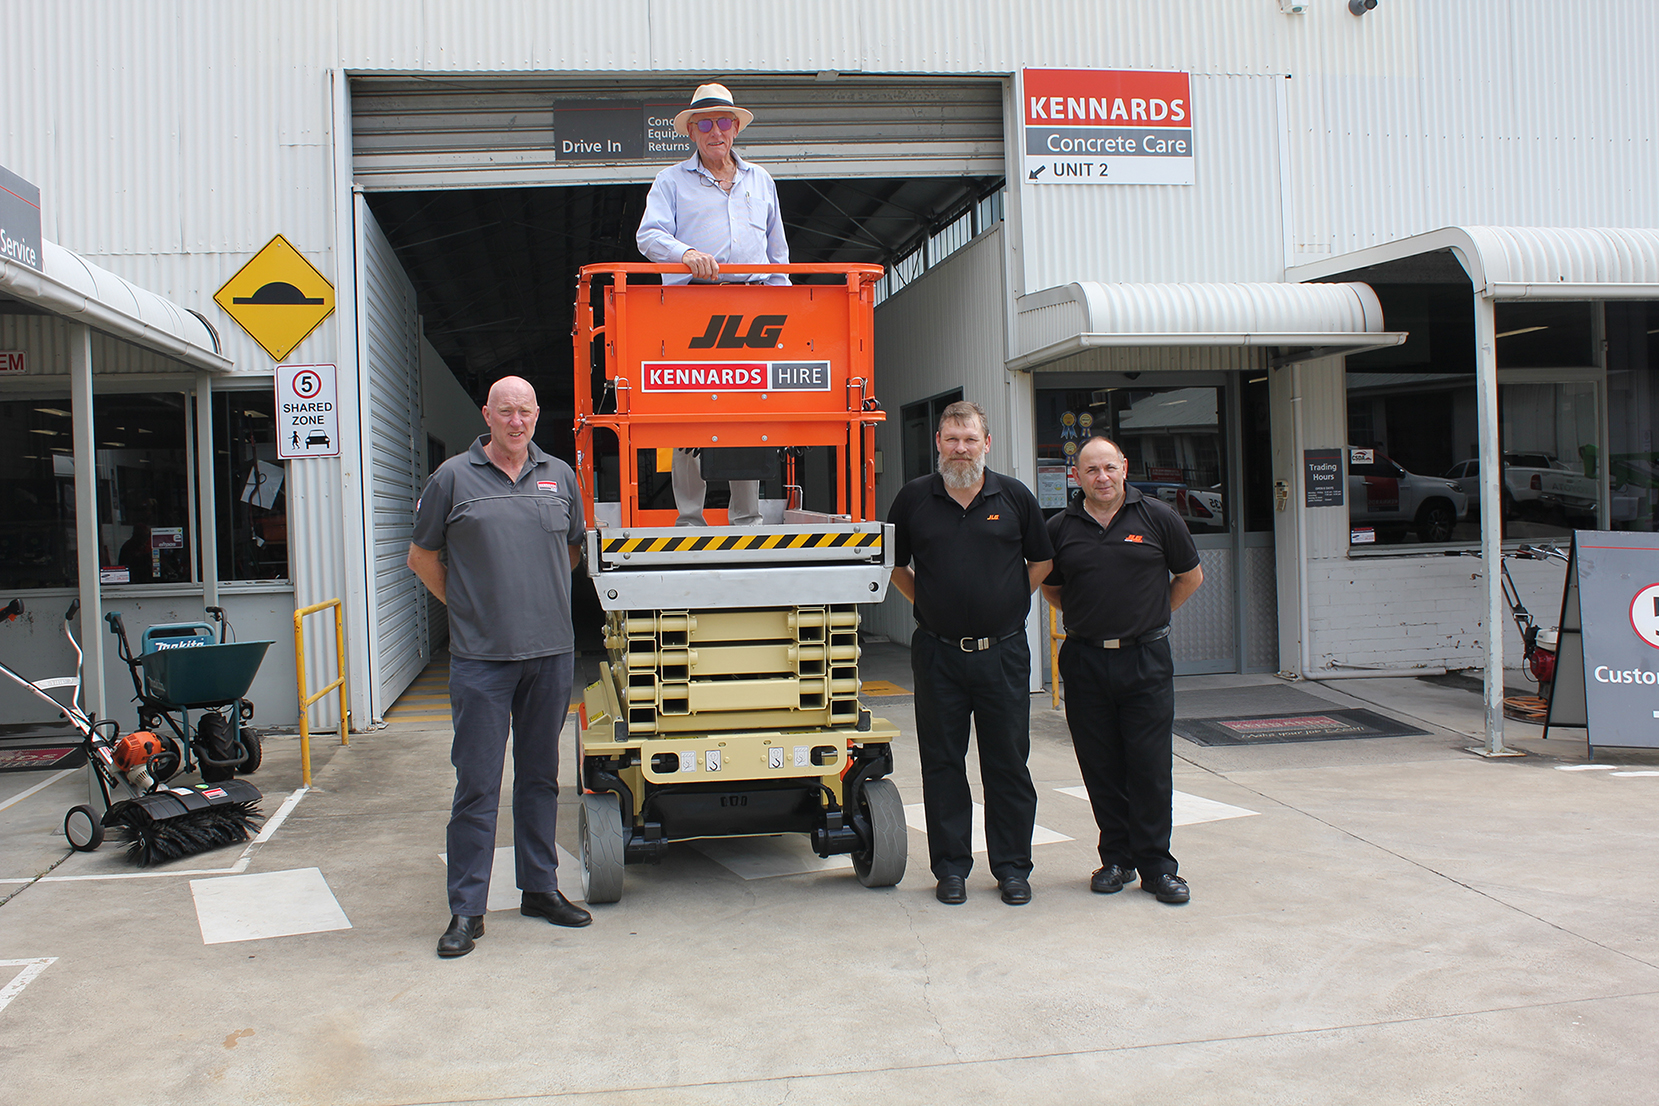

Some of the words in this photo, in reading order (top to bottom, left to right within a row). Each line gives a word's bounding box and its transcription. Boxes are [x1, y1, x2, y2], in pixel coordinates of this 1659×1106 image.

[1030, 96, 1186, 122] KENNARDS
[647, 116, 675, 127] Conc
[648, 128, 689, 141] Equip
[562, 139, 602, 154] Drive
[607, 139, 622, 153] In
[648, 142, 690, 152] Returns
[1046, 133, 1137, 153] Concrete
[1142, 134, 1187, 154] Care
[1053, 162, 1094, 177] UNIT
[1099, 163, 1109, 177] 2
[0, 228, 37, 266] Service
[688, 314, 788, 349] JLG
[301, 375, 313, 393] 5
[650, 367, 762, 386] KENNARDS
[778, 367, 823, 385] HIRE
[282, 402, 333, 413] SHARED
[291, 415, 325, 426] ZONE
[1309, 463, 1338, 472] Trading
[1594, 665, 1659, 685] Custo
